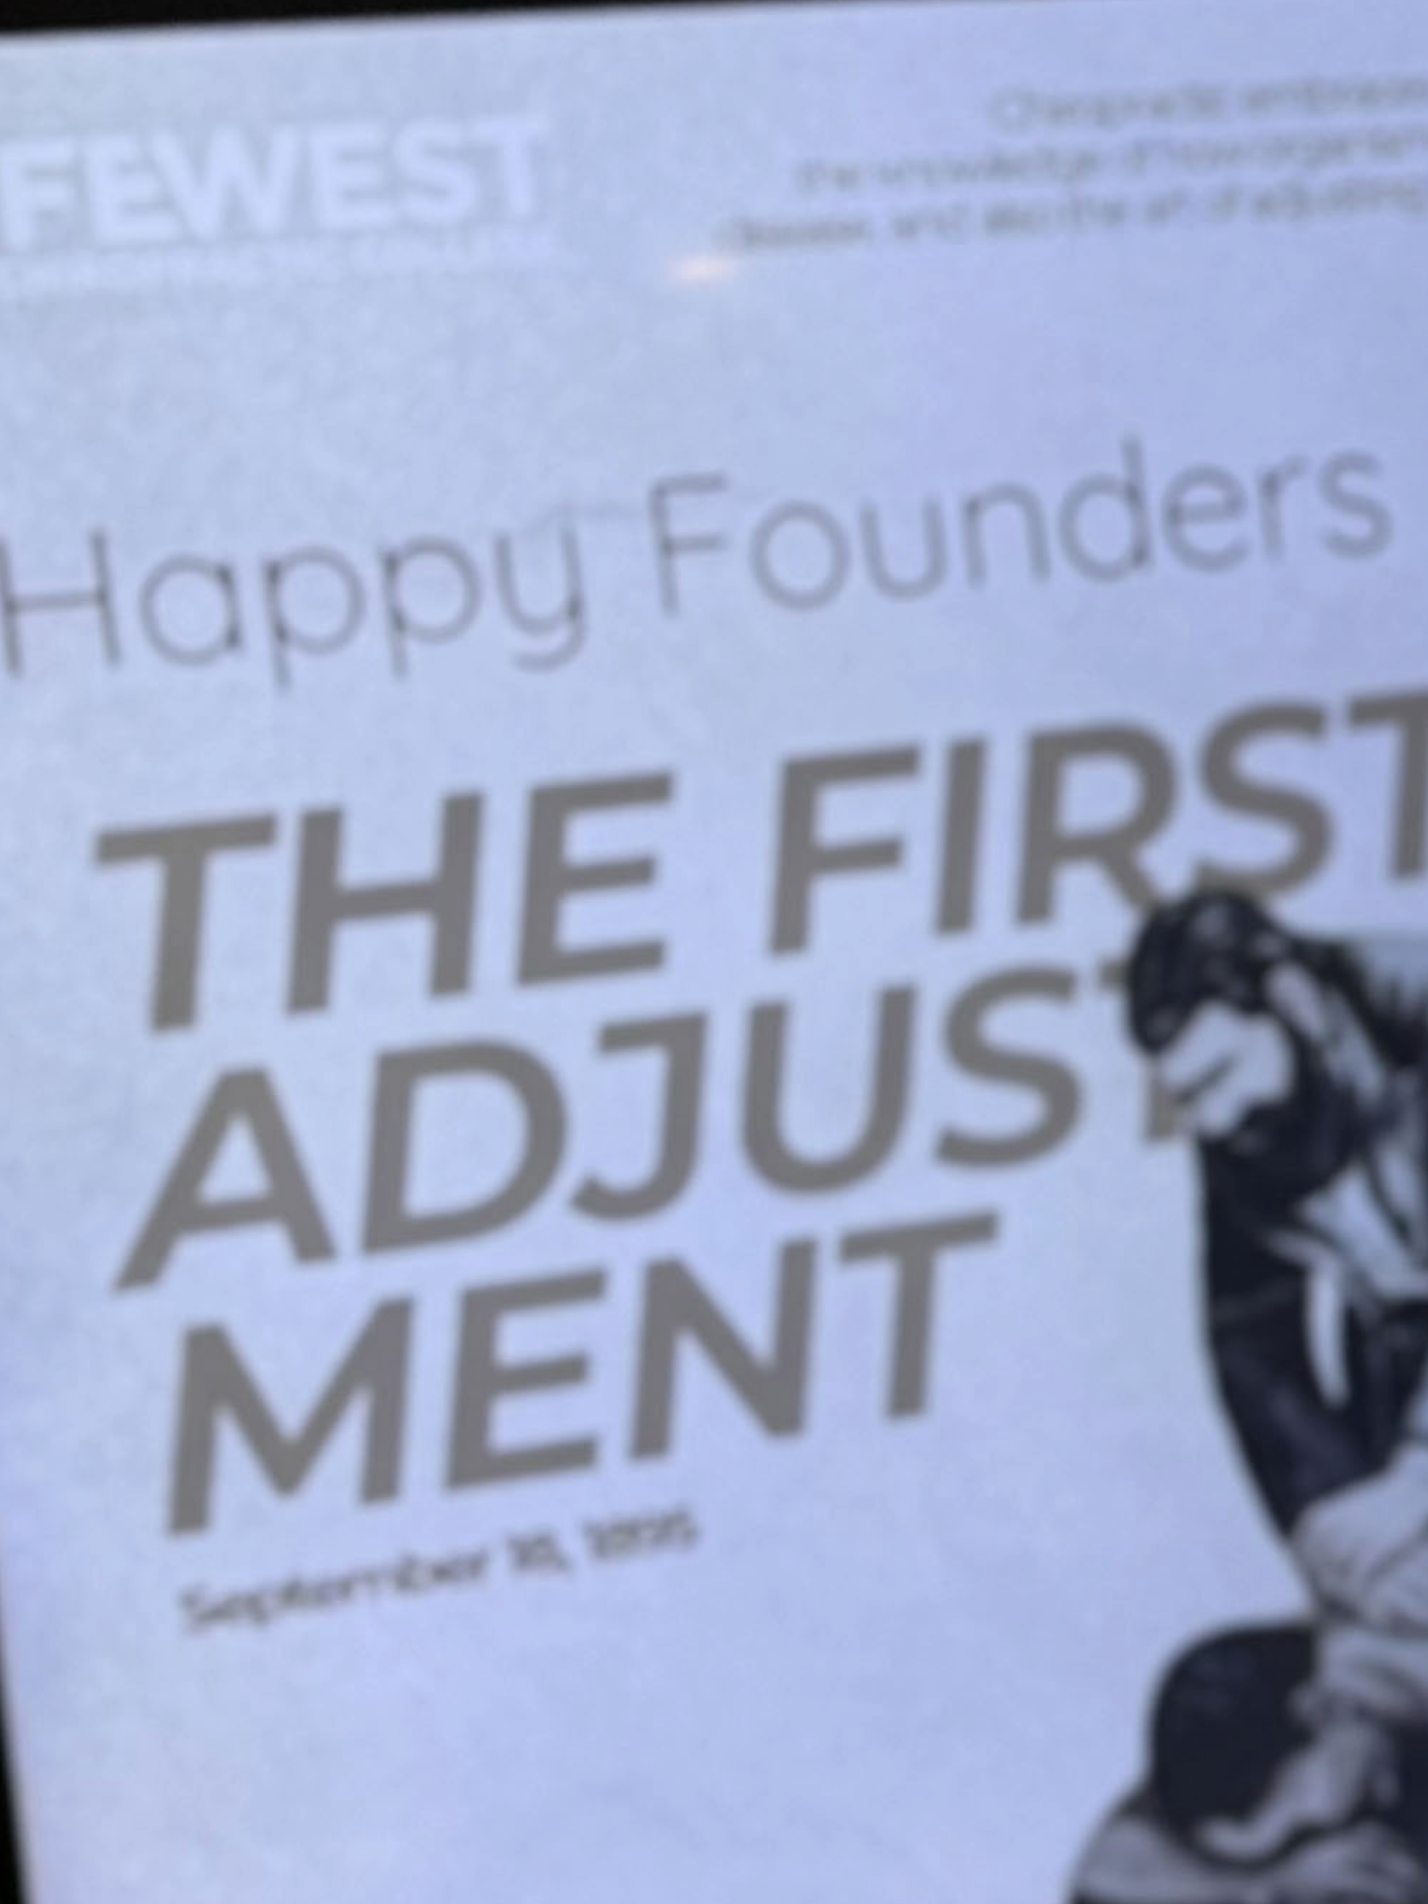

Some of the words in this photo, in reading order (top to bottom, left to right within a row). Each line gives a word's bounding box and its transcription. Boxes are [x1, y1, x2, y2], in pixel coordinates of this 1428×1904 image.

[0, 524, 588, 692] Happy
[648, 432, 1392, 618] Founders
[94, 767, 676, 1036] THE
[164, 1205, 1000, 1537] MENT
